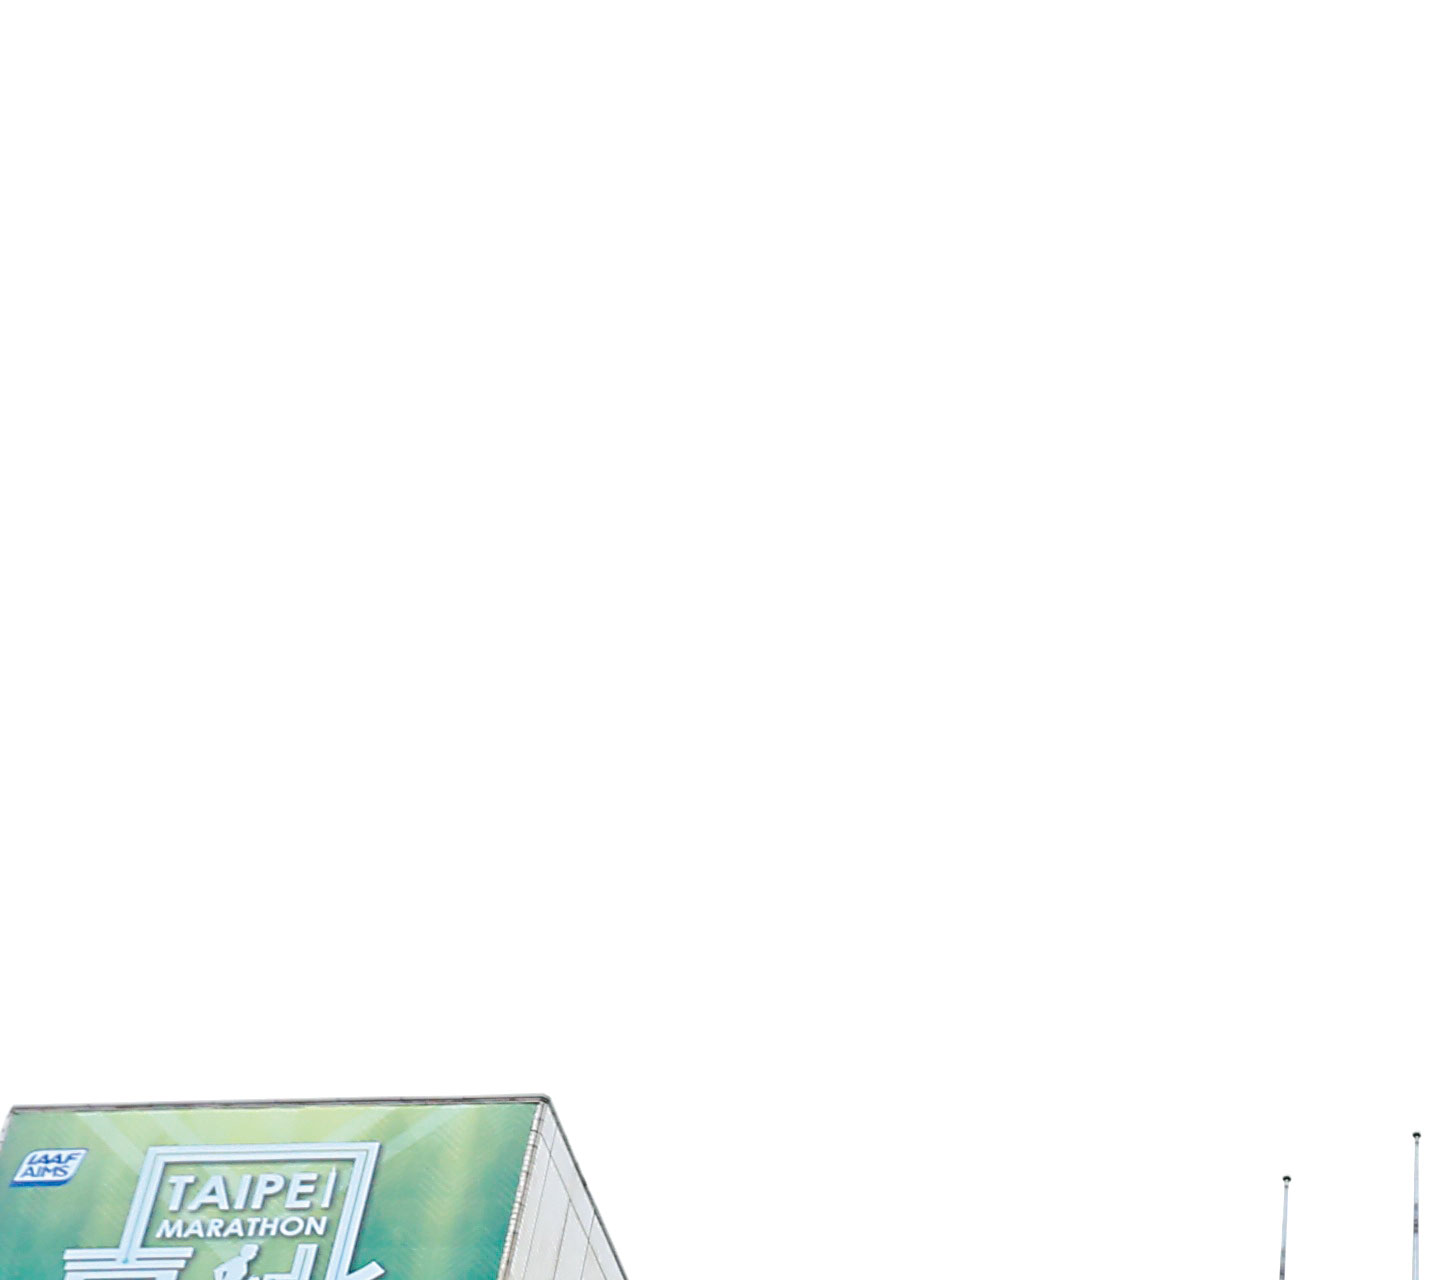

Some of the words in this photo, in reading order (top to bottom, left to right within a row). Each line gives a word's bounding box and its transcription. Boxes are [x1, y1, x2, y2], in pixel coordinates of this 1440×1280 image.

[21, 1166, 69, 1178] AIMS
[166, 1165, 338, 1212] TAIPEI
[155, 1215, 328, 1238] MARATHON
